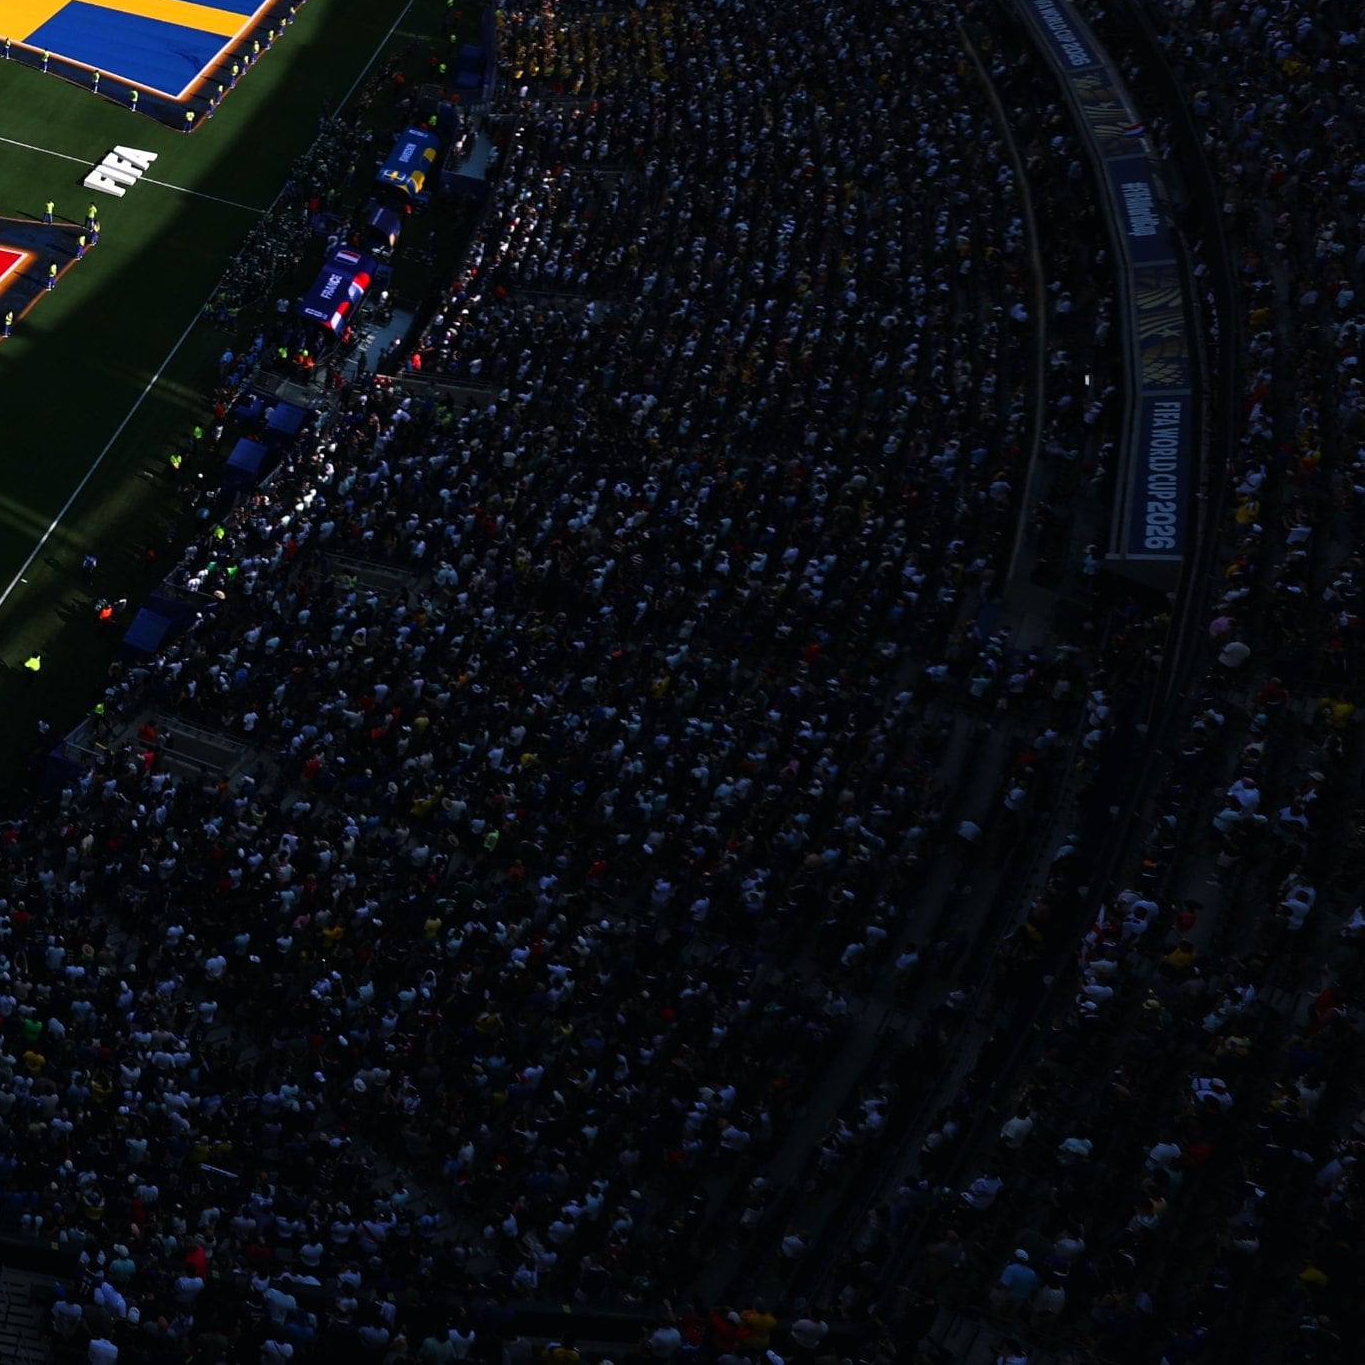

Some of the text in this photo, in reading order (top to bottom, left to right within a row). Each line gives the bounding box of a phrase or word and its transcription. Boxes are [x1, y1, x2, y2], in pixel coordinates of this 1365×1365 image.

[83, 145, 159, 198] FIFA
[320, 273, 344, 300] FRANCE
[1144, 401, 1182, 549] FIFA WORLD CUP 2026
